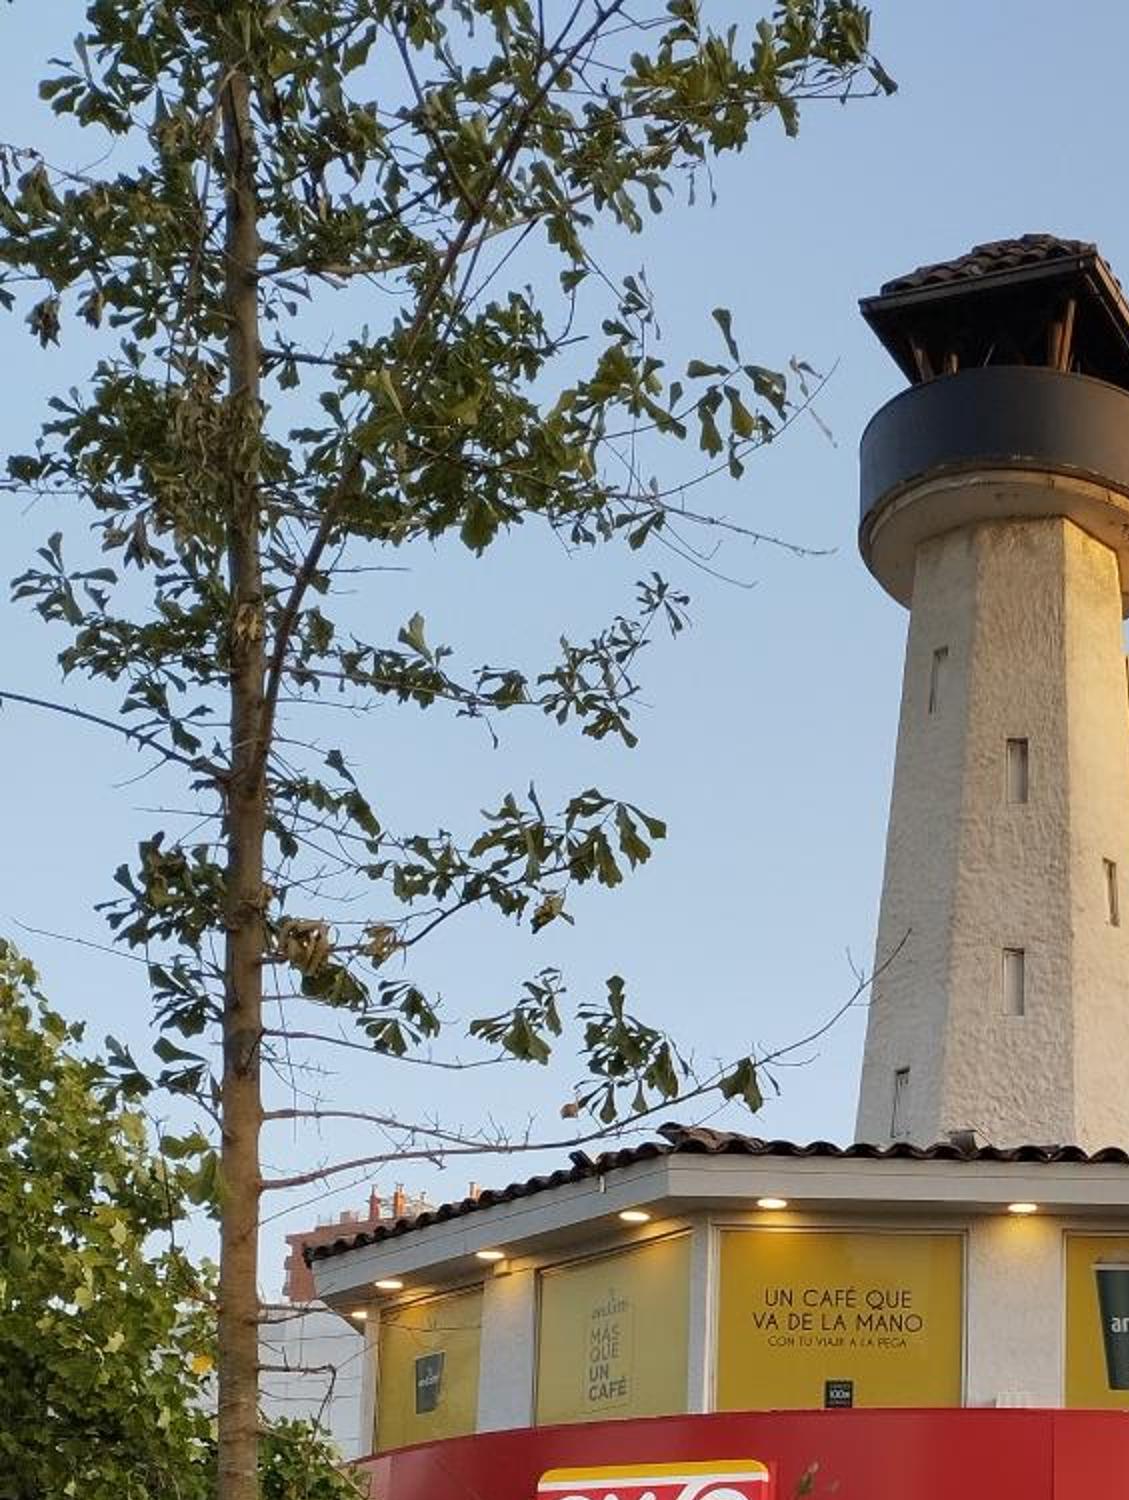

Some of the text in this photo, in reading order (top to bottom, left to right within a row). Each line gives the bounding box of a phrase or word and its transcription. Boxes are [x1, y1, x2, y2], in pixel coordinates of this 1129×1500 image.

[765, 1285, 913, 1311] UN CAFÉ QUE
[753, 1311, 923, 1333] VA DE LA MANO
[589, 1363, 609, 1382] UN
[588, 1375, 627, 1401] CAFÉ
